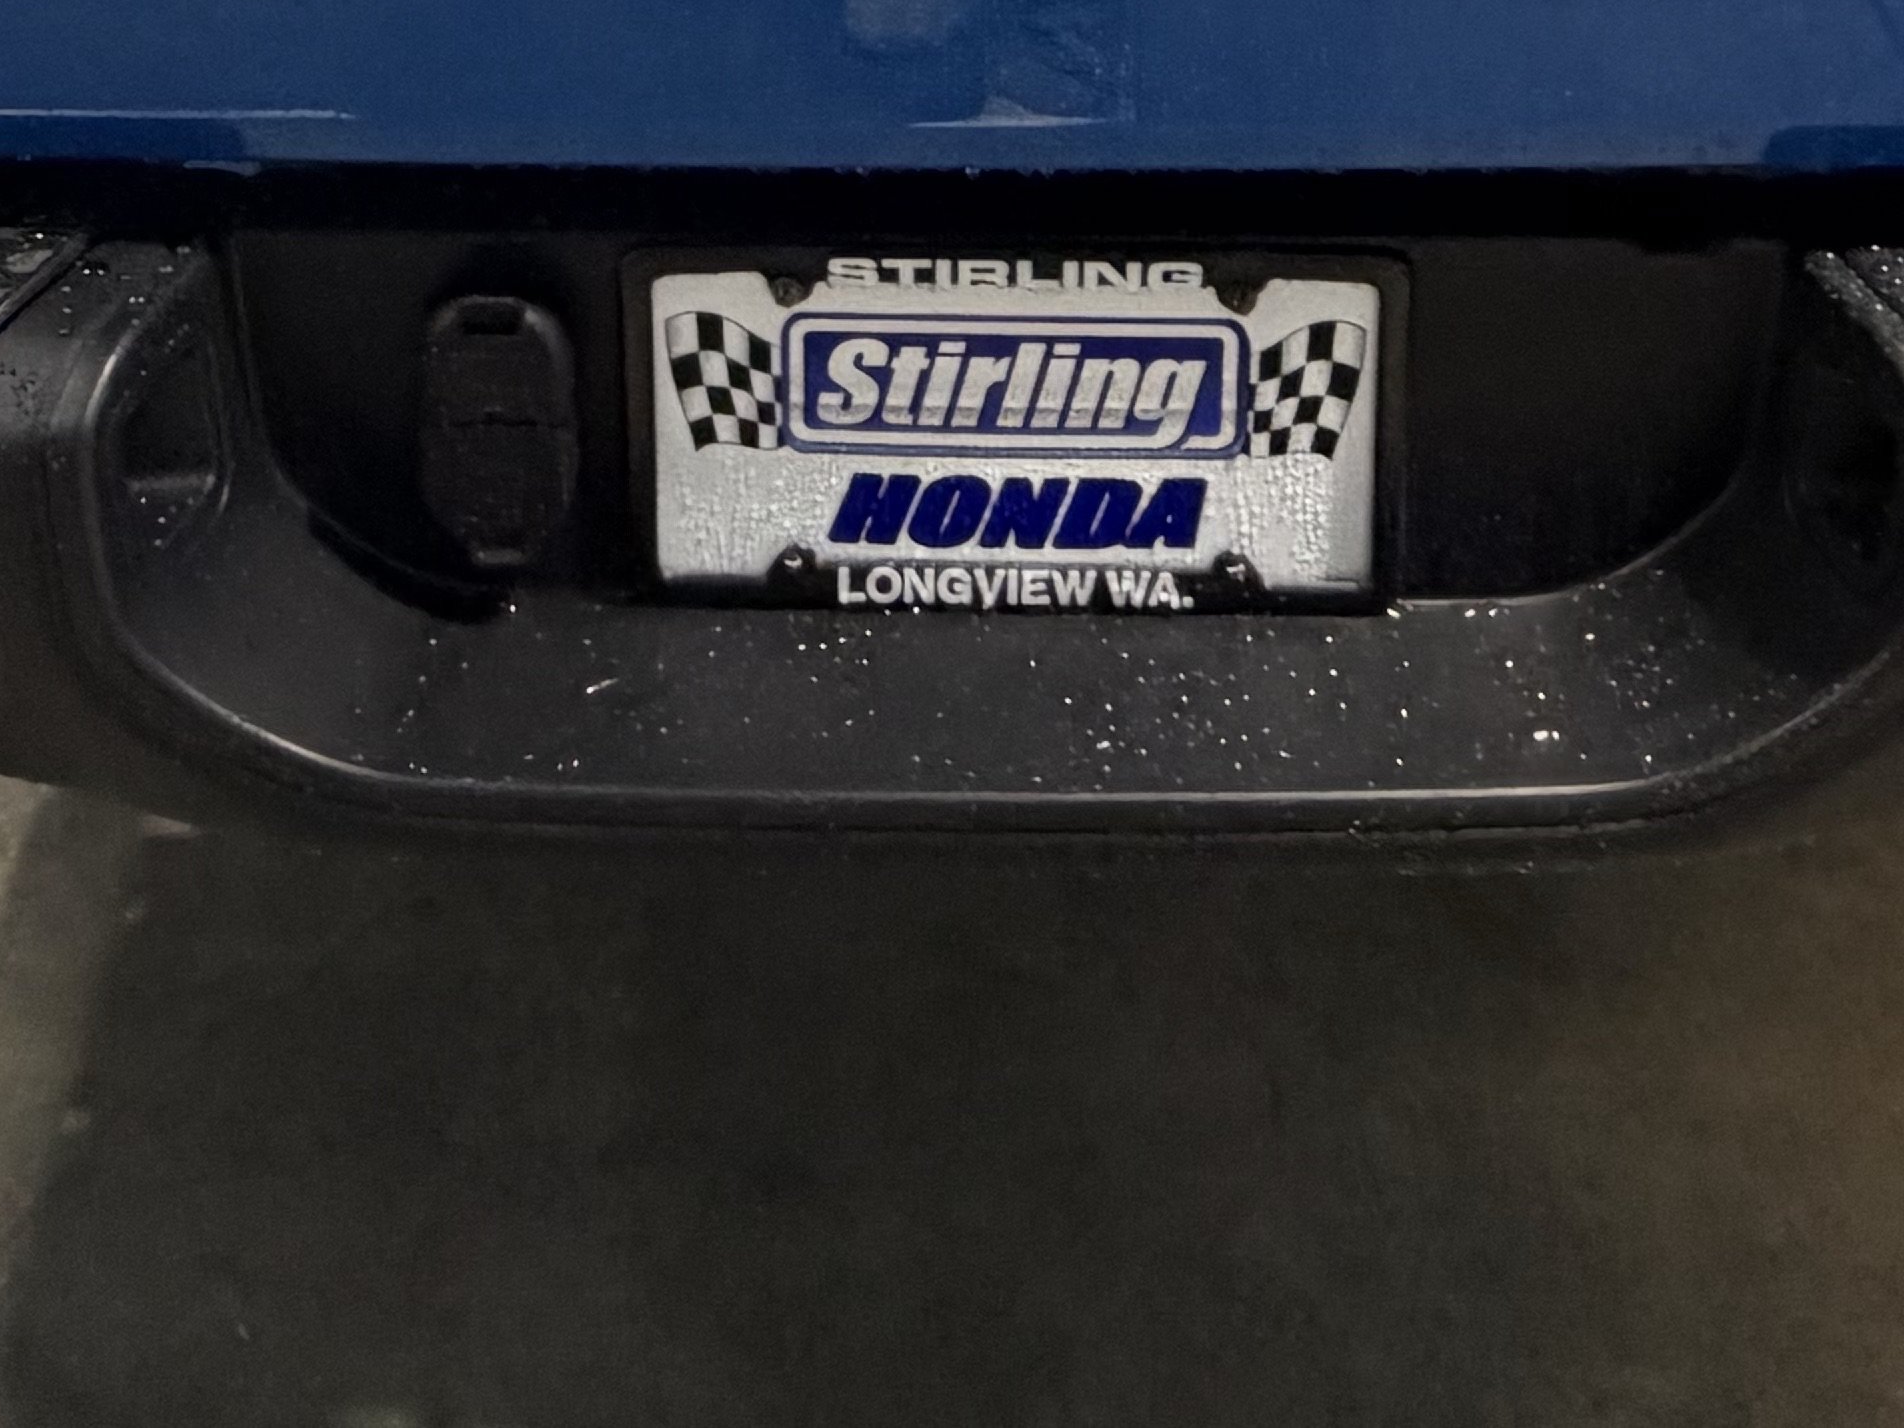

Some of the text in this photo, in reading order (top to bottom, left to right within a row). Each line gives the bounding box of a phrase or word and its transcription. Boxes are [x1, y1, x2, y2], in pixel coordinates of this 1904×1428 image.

[826, 257, 1204, 290] STIRLING
[816, 338, 1208, 449] Stirling
[828, 472, 1209, 550] HONDA
[836, 565, 1096, 609] LONGVIEW
